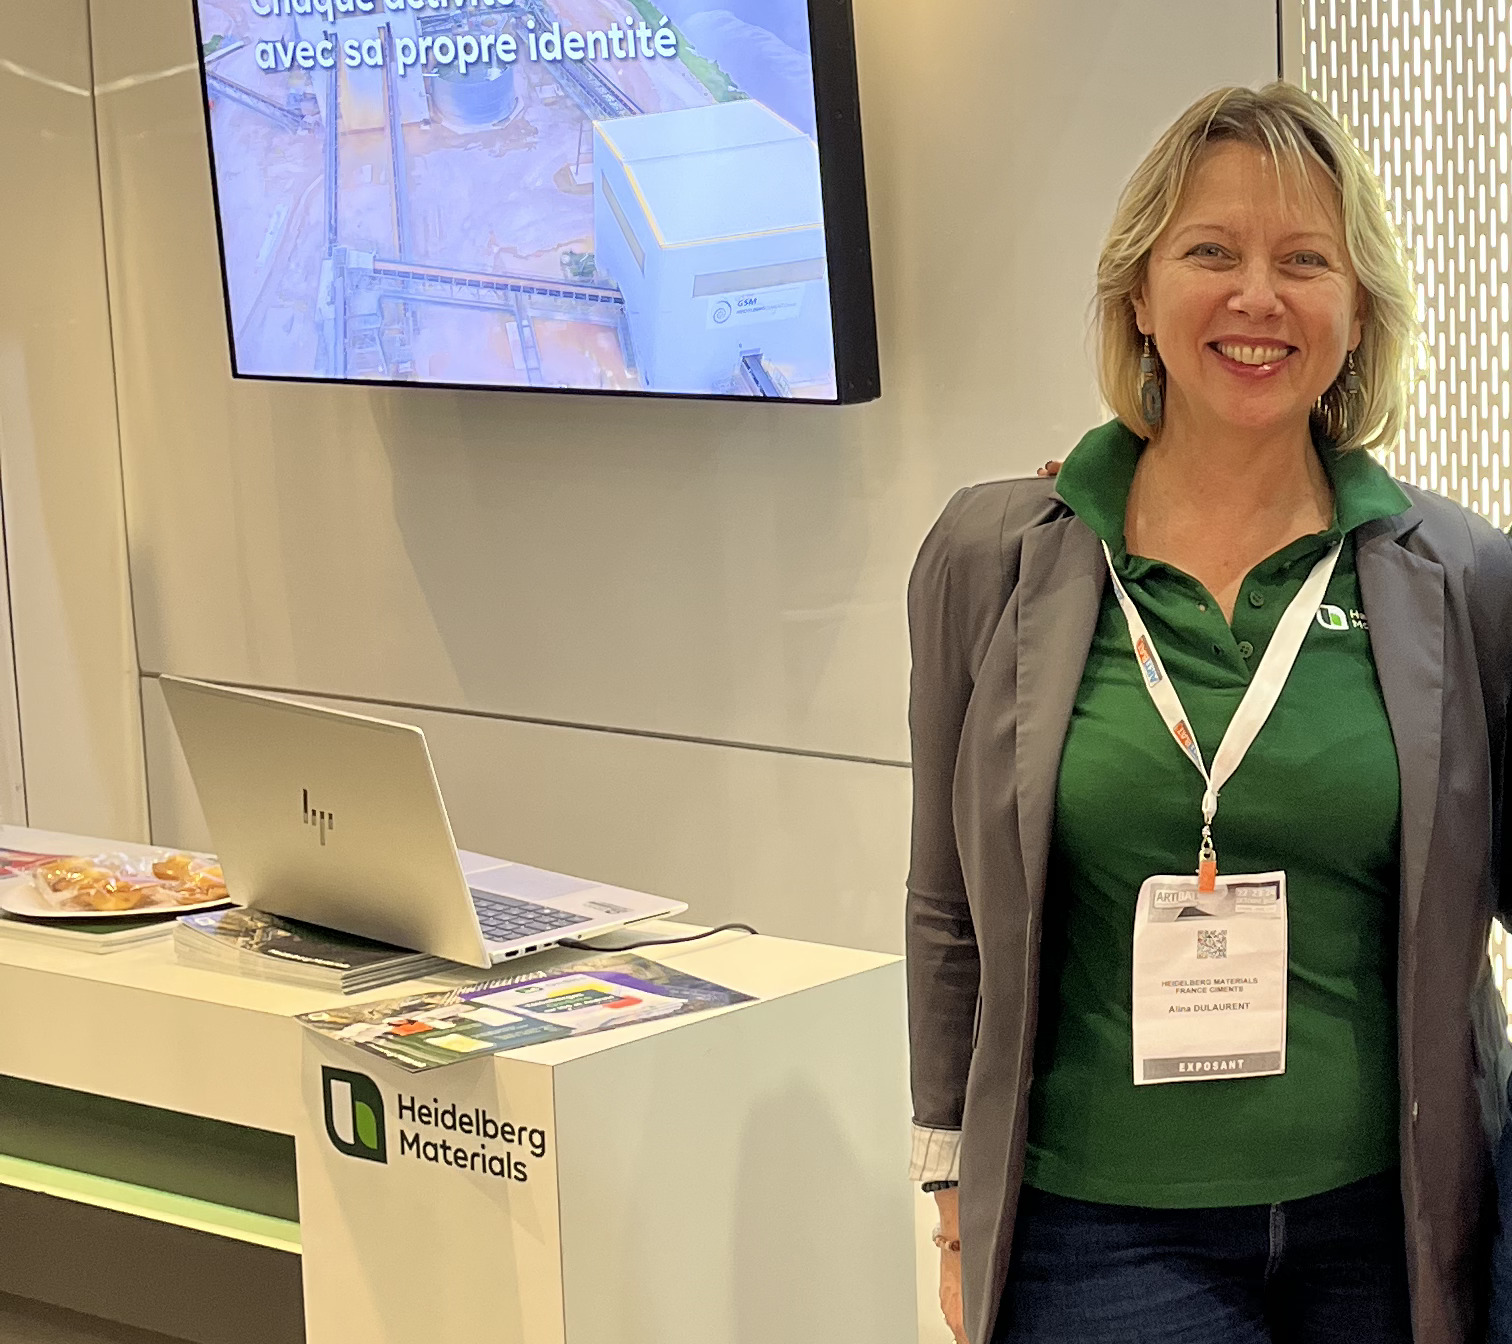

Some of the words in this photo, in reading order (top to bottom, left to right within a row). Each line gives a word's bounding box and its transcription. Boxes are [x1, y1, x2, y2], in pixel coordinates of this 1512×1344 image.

[255, 37, 335, 70] avec
[343, 37, 385, 68] sa
[396, 32, 518, 74] propre
[528, 16, 678, 63] identité
[1161, 978, 1212, 987] HEIDELBERG
[1213, 977, 1259, 986] MATERIALS
[1175, 986, 1208, 994] FRANCE
[1209, 985, 1244, 993] CIMENTS
[1193, 1002, 1251, 1012] DULAURENT
[1178, 1059, 1245, 1073] EXPOSANT
[397, 1093, 546, 1158] Heidelberg
[399, 1129, 528, 1182] Materials
